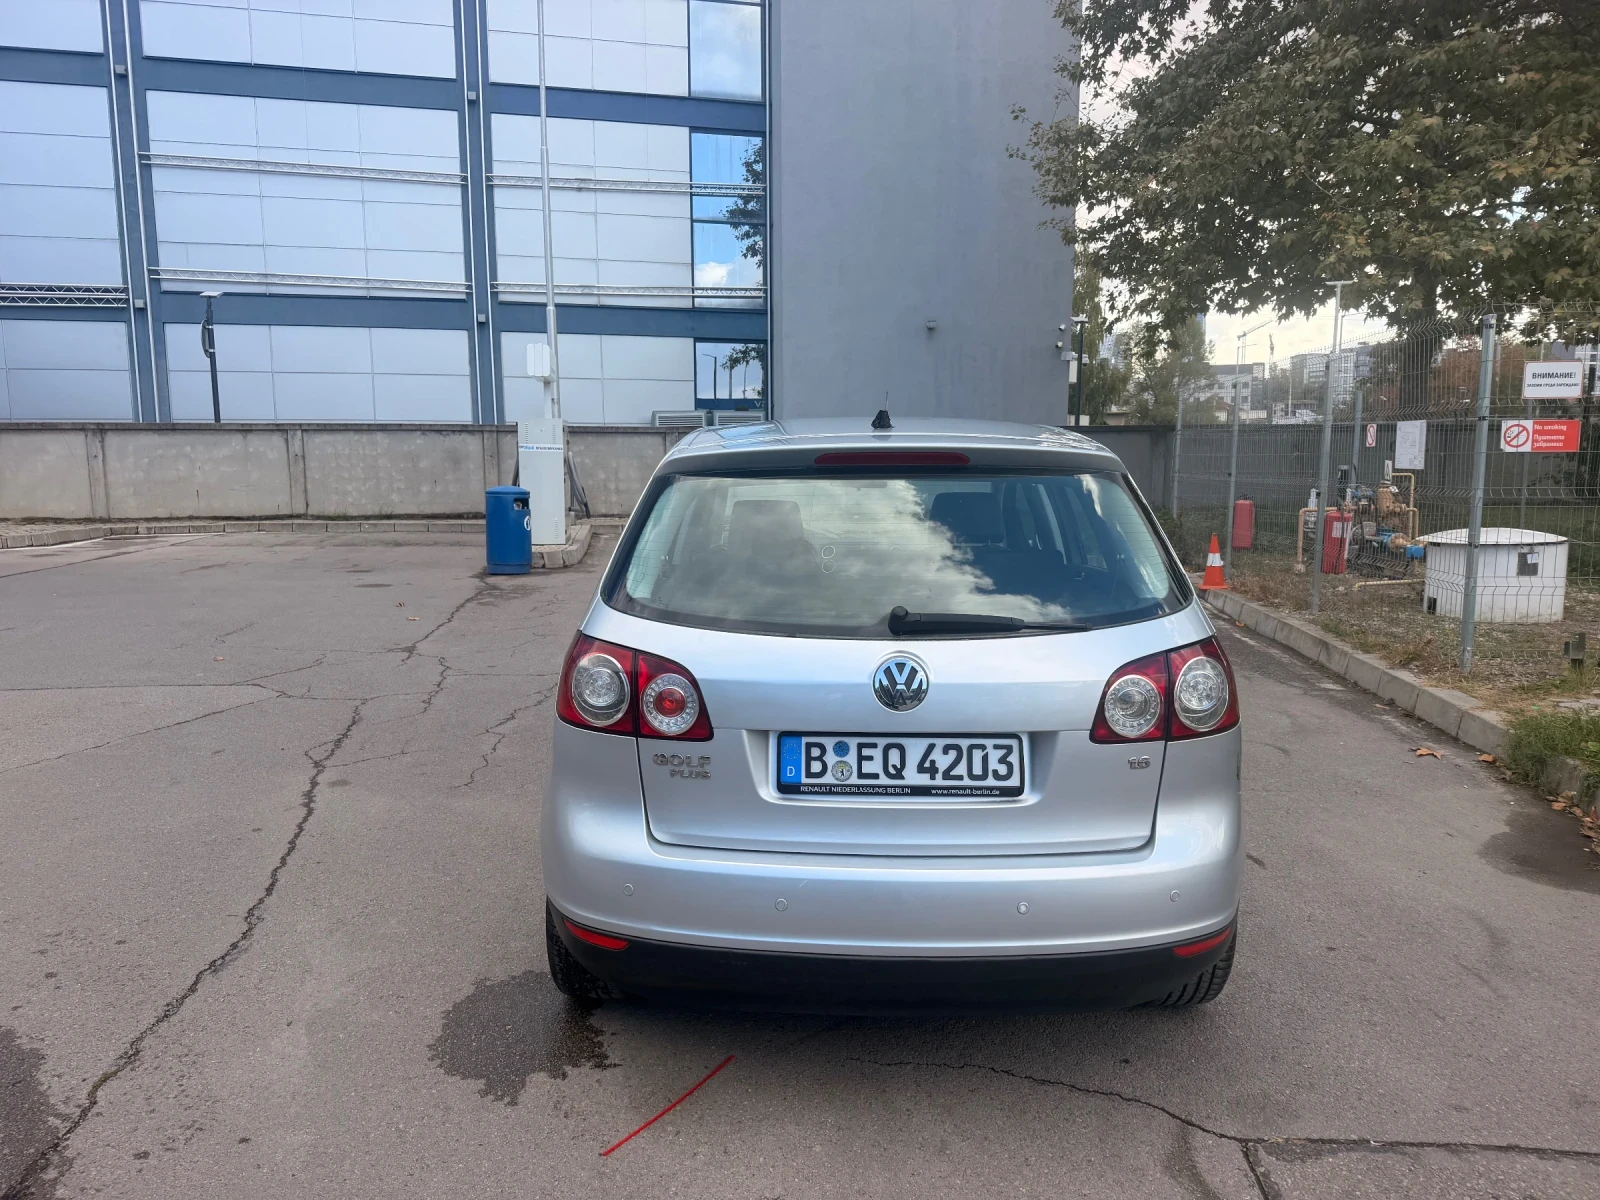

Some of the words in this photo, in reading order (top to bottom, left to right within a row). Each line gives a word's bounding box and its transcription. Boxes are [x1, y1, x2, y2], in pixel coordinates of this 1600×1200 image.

[652, 753, 711, 769] GOLF
[805, 742, 828, 779] B
[857, 743, 906, 780] EQ
[917, 743, 1014, 781] 4203
[669, 768, 712, 780] PLUS
[787, 766, 796, 777] D
